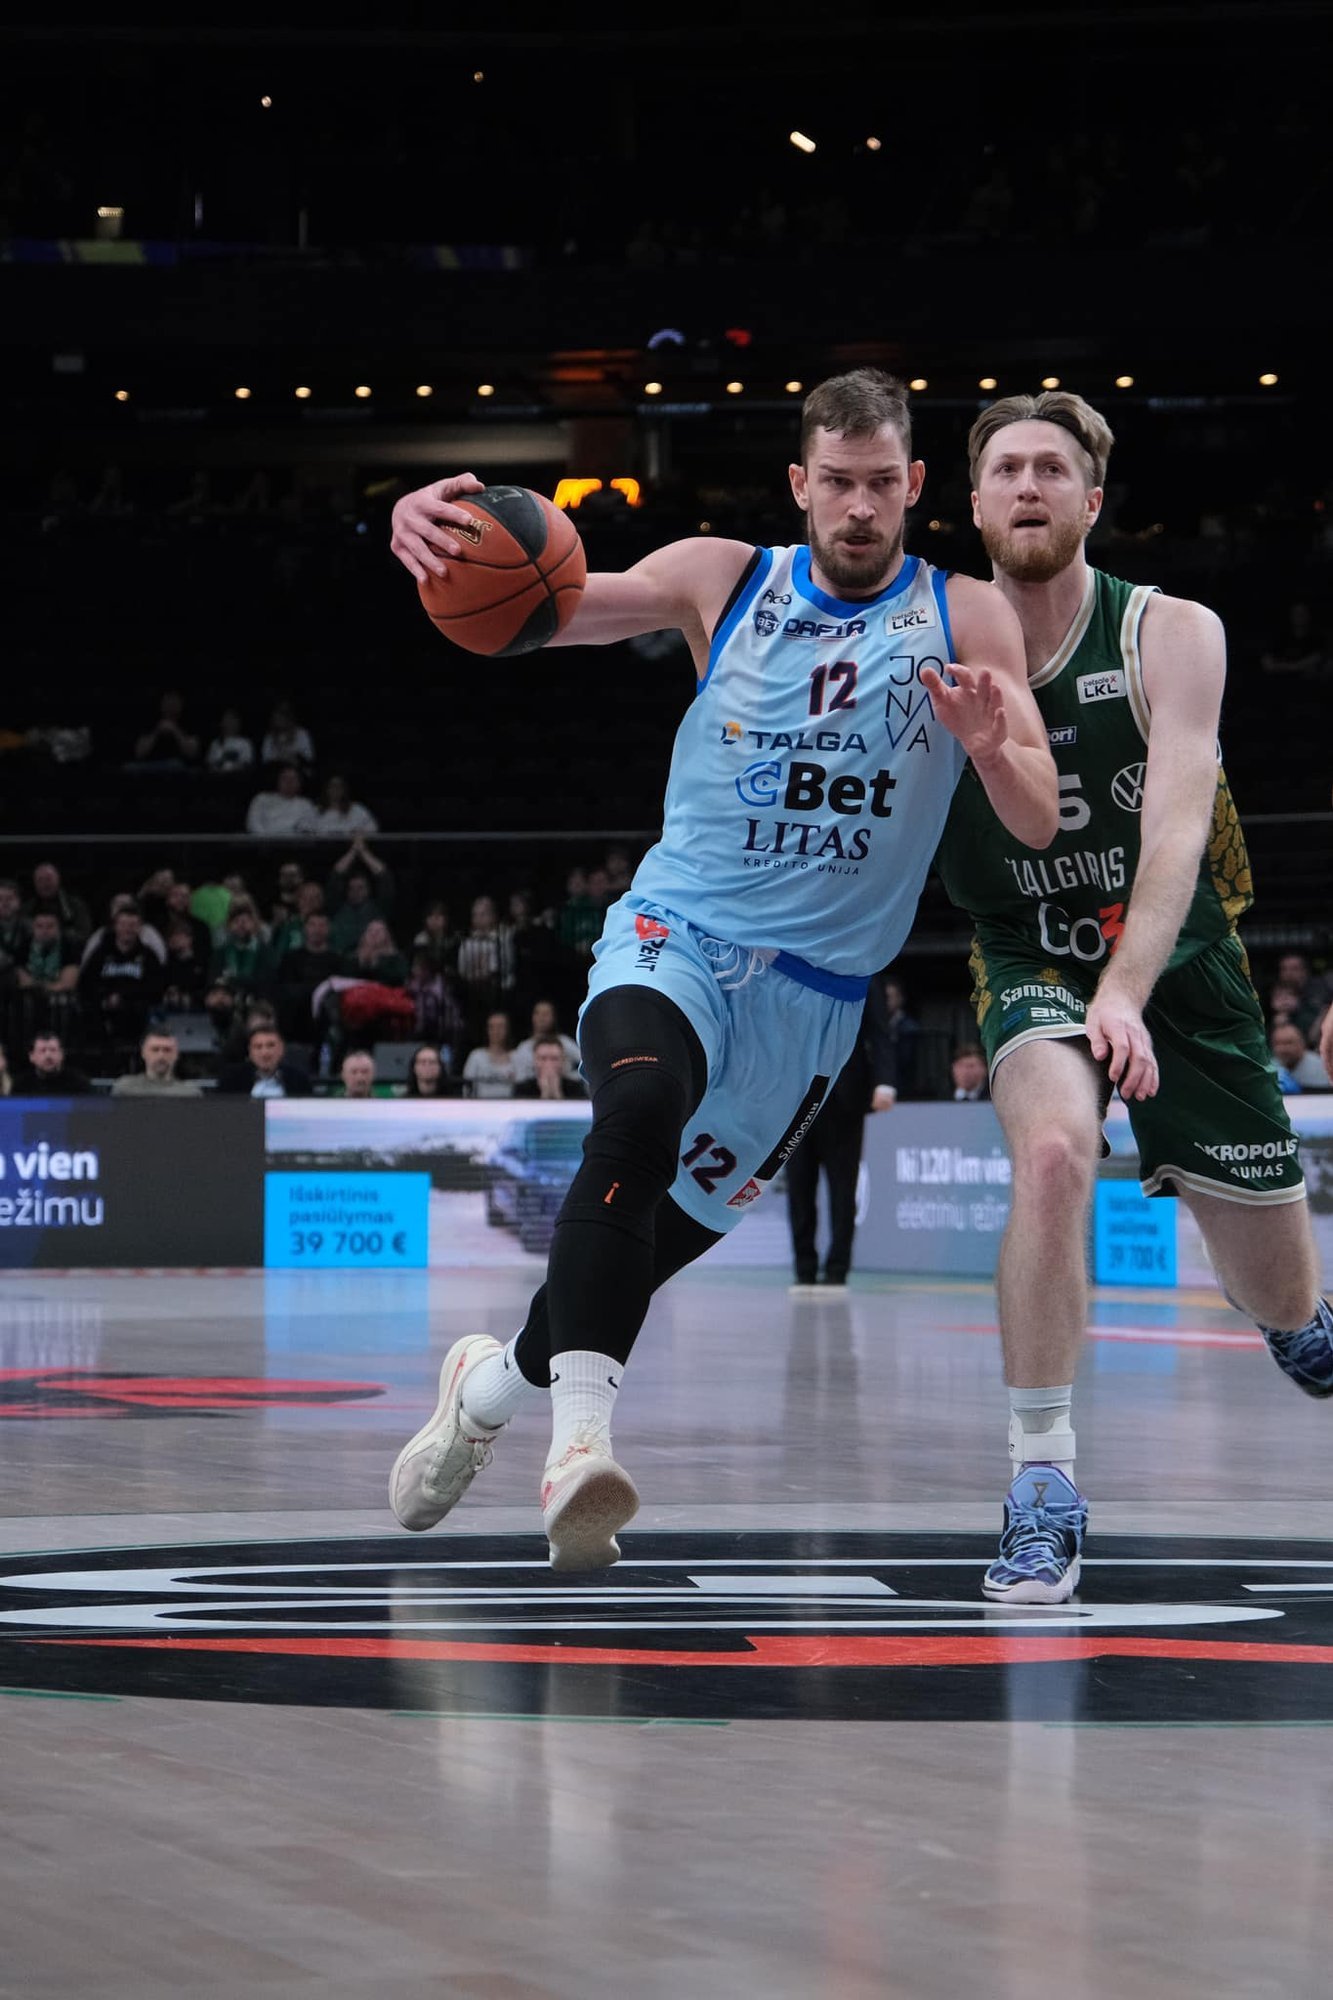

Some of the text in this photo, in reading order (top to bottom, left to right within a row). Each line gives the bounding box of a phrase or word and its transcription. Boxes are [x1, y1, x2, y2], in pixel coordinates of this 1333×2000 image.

[892, 614, 928, 631] LKL
[808, 661, 858, 716] 12
[1084, 683, 1119, 698] LKL
[748, 731, 867, 754] TALGA
[735, 760, 897, 818] CBet
[742, 818, 871, 861] LITAS
[743, 857, 860, 876] KREDITO UNIJA
[1000, 984, 1088, 1012] Samsona
[778, 1102, 819, 1160] RIZGONYS
[13, 1142, 99, 1180] vien
[1194, 1138, 1298, 1161] KROPOLIS
[681, 1133, 737, 1195] 12
[983, 1147, 1012, 1184] vie
[1220, 1163, 1284, 1179] AUNAS
[291, 1231, 407, 1255] 39 700 €
